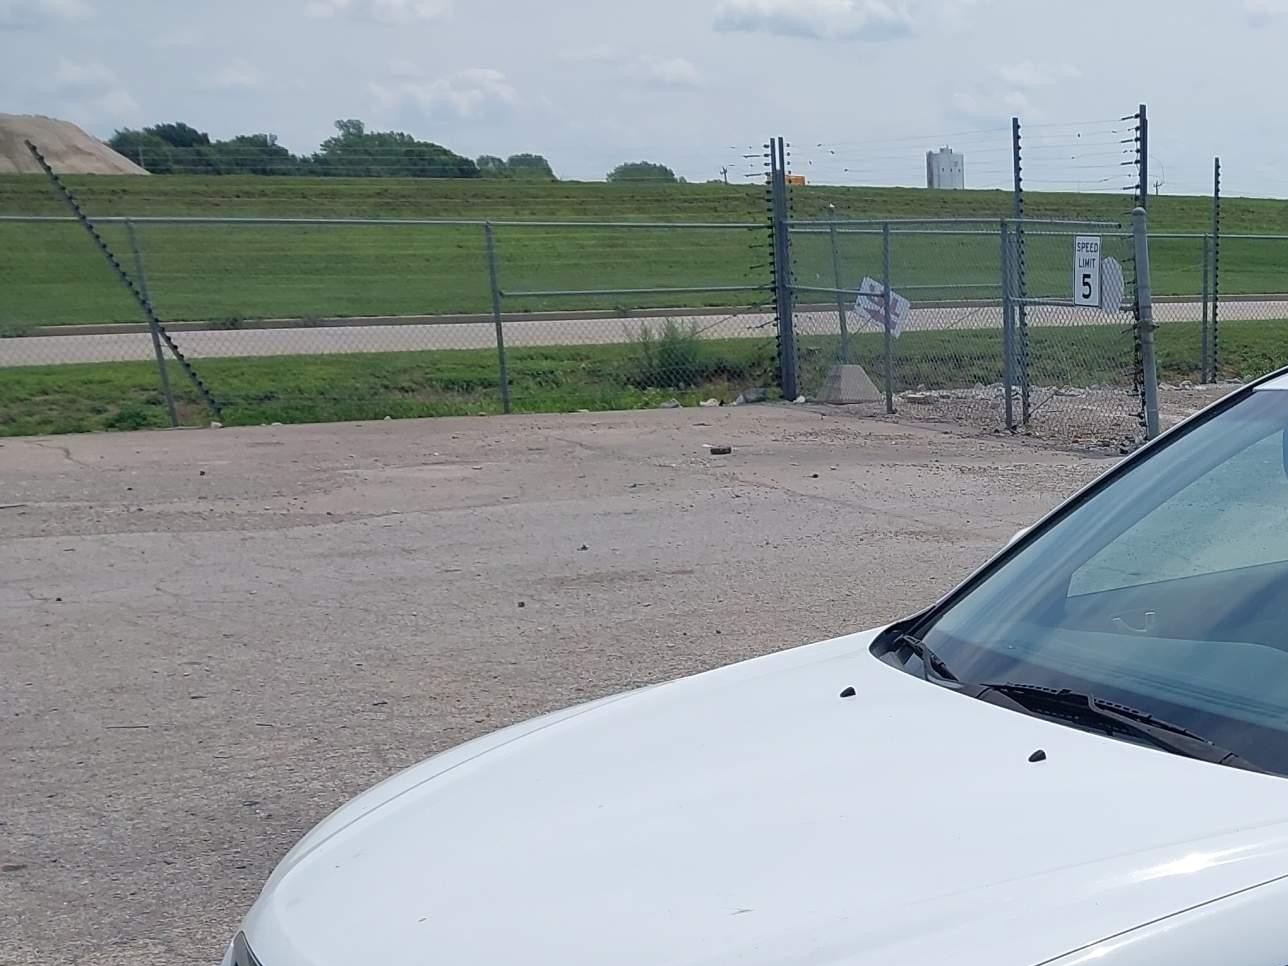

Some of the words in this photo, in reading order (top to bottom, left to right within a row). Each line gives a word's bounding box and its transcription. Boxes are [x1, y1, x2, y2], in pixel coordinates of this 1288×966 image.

[1077, 242, 1098, 252] SPEED
[1078, 258, 1096, 268] LIMIT
[1082, 273, 1092, 299] 5
